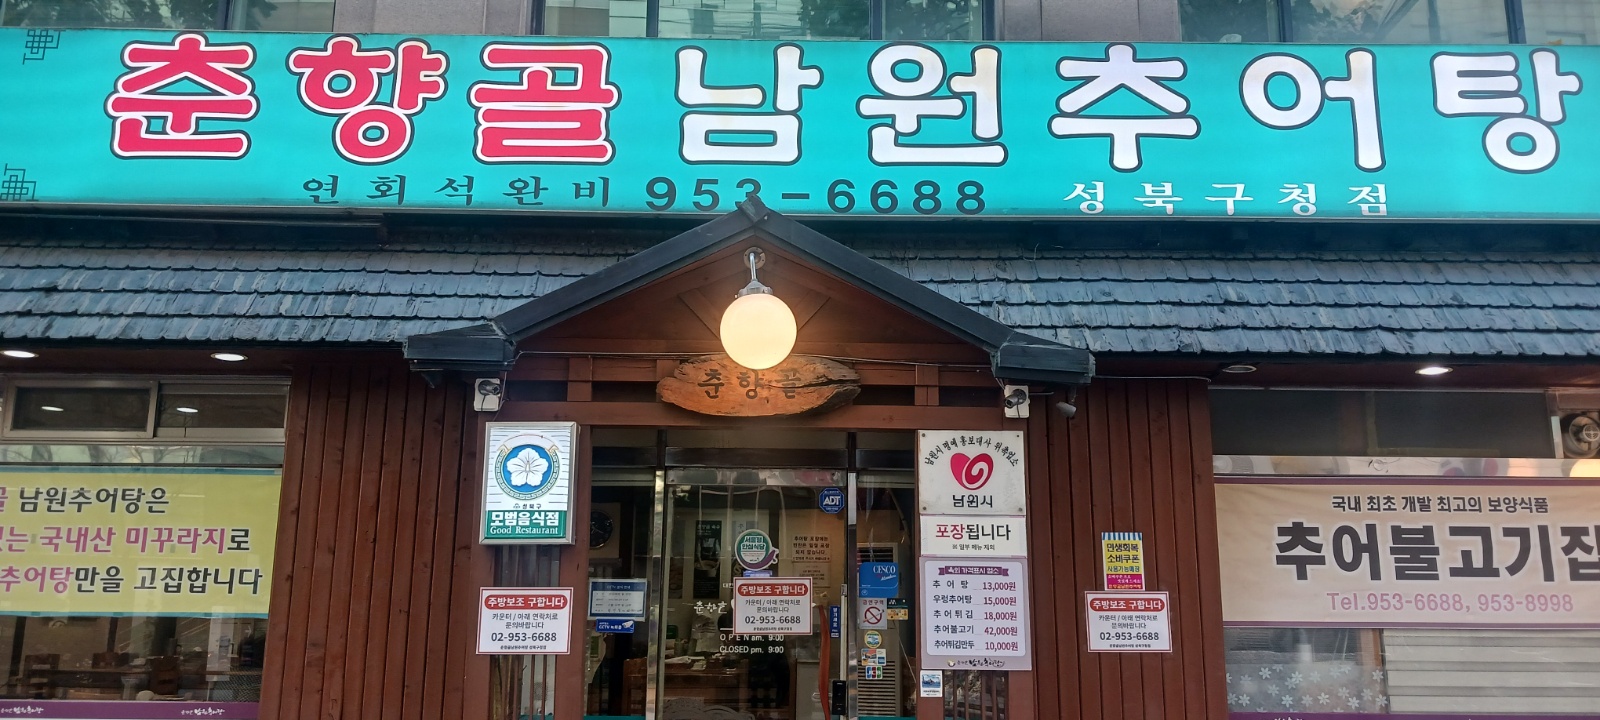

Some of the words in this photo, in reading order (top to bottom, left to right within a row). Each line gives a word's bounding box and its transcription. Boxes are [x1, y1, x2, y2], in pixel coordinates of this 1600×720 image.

[106, 32, 618, 165] 춘향골
[678, 43, 1583, 173] 남원추어탕
[645, 177, 987, 214] 953-6688
[697, 368, 802, 400] 춘향골
[924, 444, 944, 466] 남원시
[959, 435, 992, 448] 홍보대사
[19, 486, 170, 514] 남원추어탕은
[823, 495, 841, 505] ADT
[952, 494, 993, 508] 남원시
[1331, 495, 1362, 513] 국내
[1366, 495, 1398, 513] 최초
[1401, 496, 1432, 513] 개발
[1437, 496, 1483, 513] 최고의
[1487, 497, 1549, 514] 보양식품
[490, 511, 559, 526] 모범음식점
[490, 526, 512, 534] Good
[515, 526, 558, 535] Restaurant
[935, 523, 1011, 541] 포장됩니다
[39, 526, 117, 553] 국내산
[125, 527, 250, 554] 미꾸라지로
[1107, 554, 1140, 563] 소비쿠폰
[873, 565, 896, 574] CESCO
[133, 566, 263, 595] 고집합니다
[740, 585, 772, 595] 주방보조
[773, 585, 806, 595] 구합니다
[982, 582, 1016, 592] 13,000원
[487, 597, 525, 608] 주방보조
[527, 597, 565, 608] 구합니다
[933, 595, 972, 604] 우렁추어탕
[983, 597, 1017, 606] 15,000원
[1093, 600, 1127, 609] 주방보조
[1128, 600, 1162, 609] 구합니다
[1326, 592, 1471, 613] Tel.953-6688,
[1477, 593, 1574, 613] 953-8998
[744, 616, 801, 625] 02-953-6688
[933, 610, 973, 619] 추어튀김
[984, 612, 1017, 621] 18,000원
[934, 625, 974, 634] 추어불고기
[984, 627, 1018, 636] 42,000원
[491, 632, 557, 642] 02-953-6688
[768, 634, 785, 642] 9:00
[1099, 632, 1160, 641] 02-953-6688
[751, 646, 764, 654] pm.
[934, 640, 975, 649] 추어튀김만두
[985, 641, 1018, 652] 10,000원
